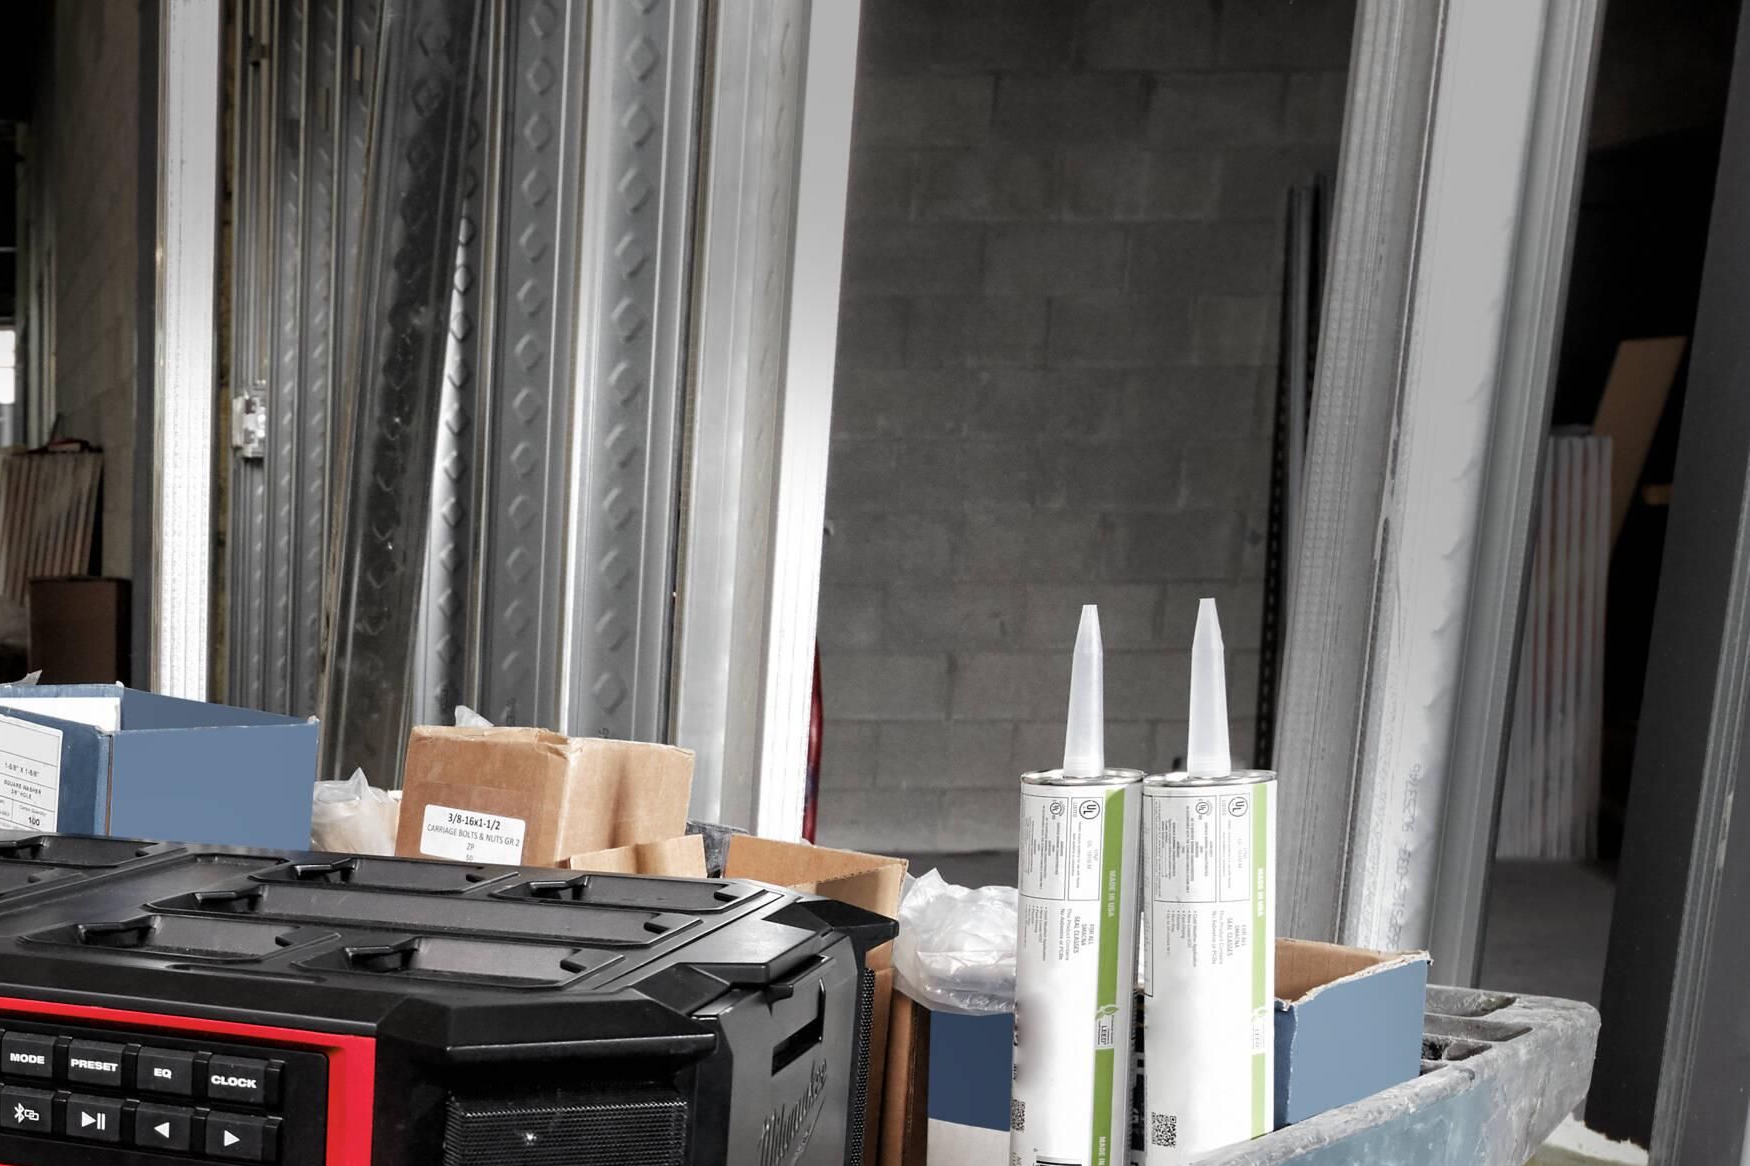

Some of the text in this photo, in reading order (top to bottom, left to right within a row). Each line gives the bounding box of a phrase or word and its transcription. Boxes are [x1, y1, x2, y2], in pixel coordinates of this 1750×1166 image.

[28, 816, 41, 826] 100
[448, 812, 501, 831] 3/8-16x1-1/2
[427, 824, 457, 836] CARRIAGE
[458, 829, 478, 840] BOLTS
[485, 834, 503, 844] NUTS
[504, 837, 514, 846] GR
[1108, 893, 1115, 902] IN
[9, 1052, 45, 1065] MODE
[70, 1058, 118, 1072] PRESET
[154, 1067, 172, 1079] EQ
[211, 1074, 257, 1089] CLOCK
[1098, 1136, 1107, 1157] MADE
[1097, 1158, 1106, 1166] IN
